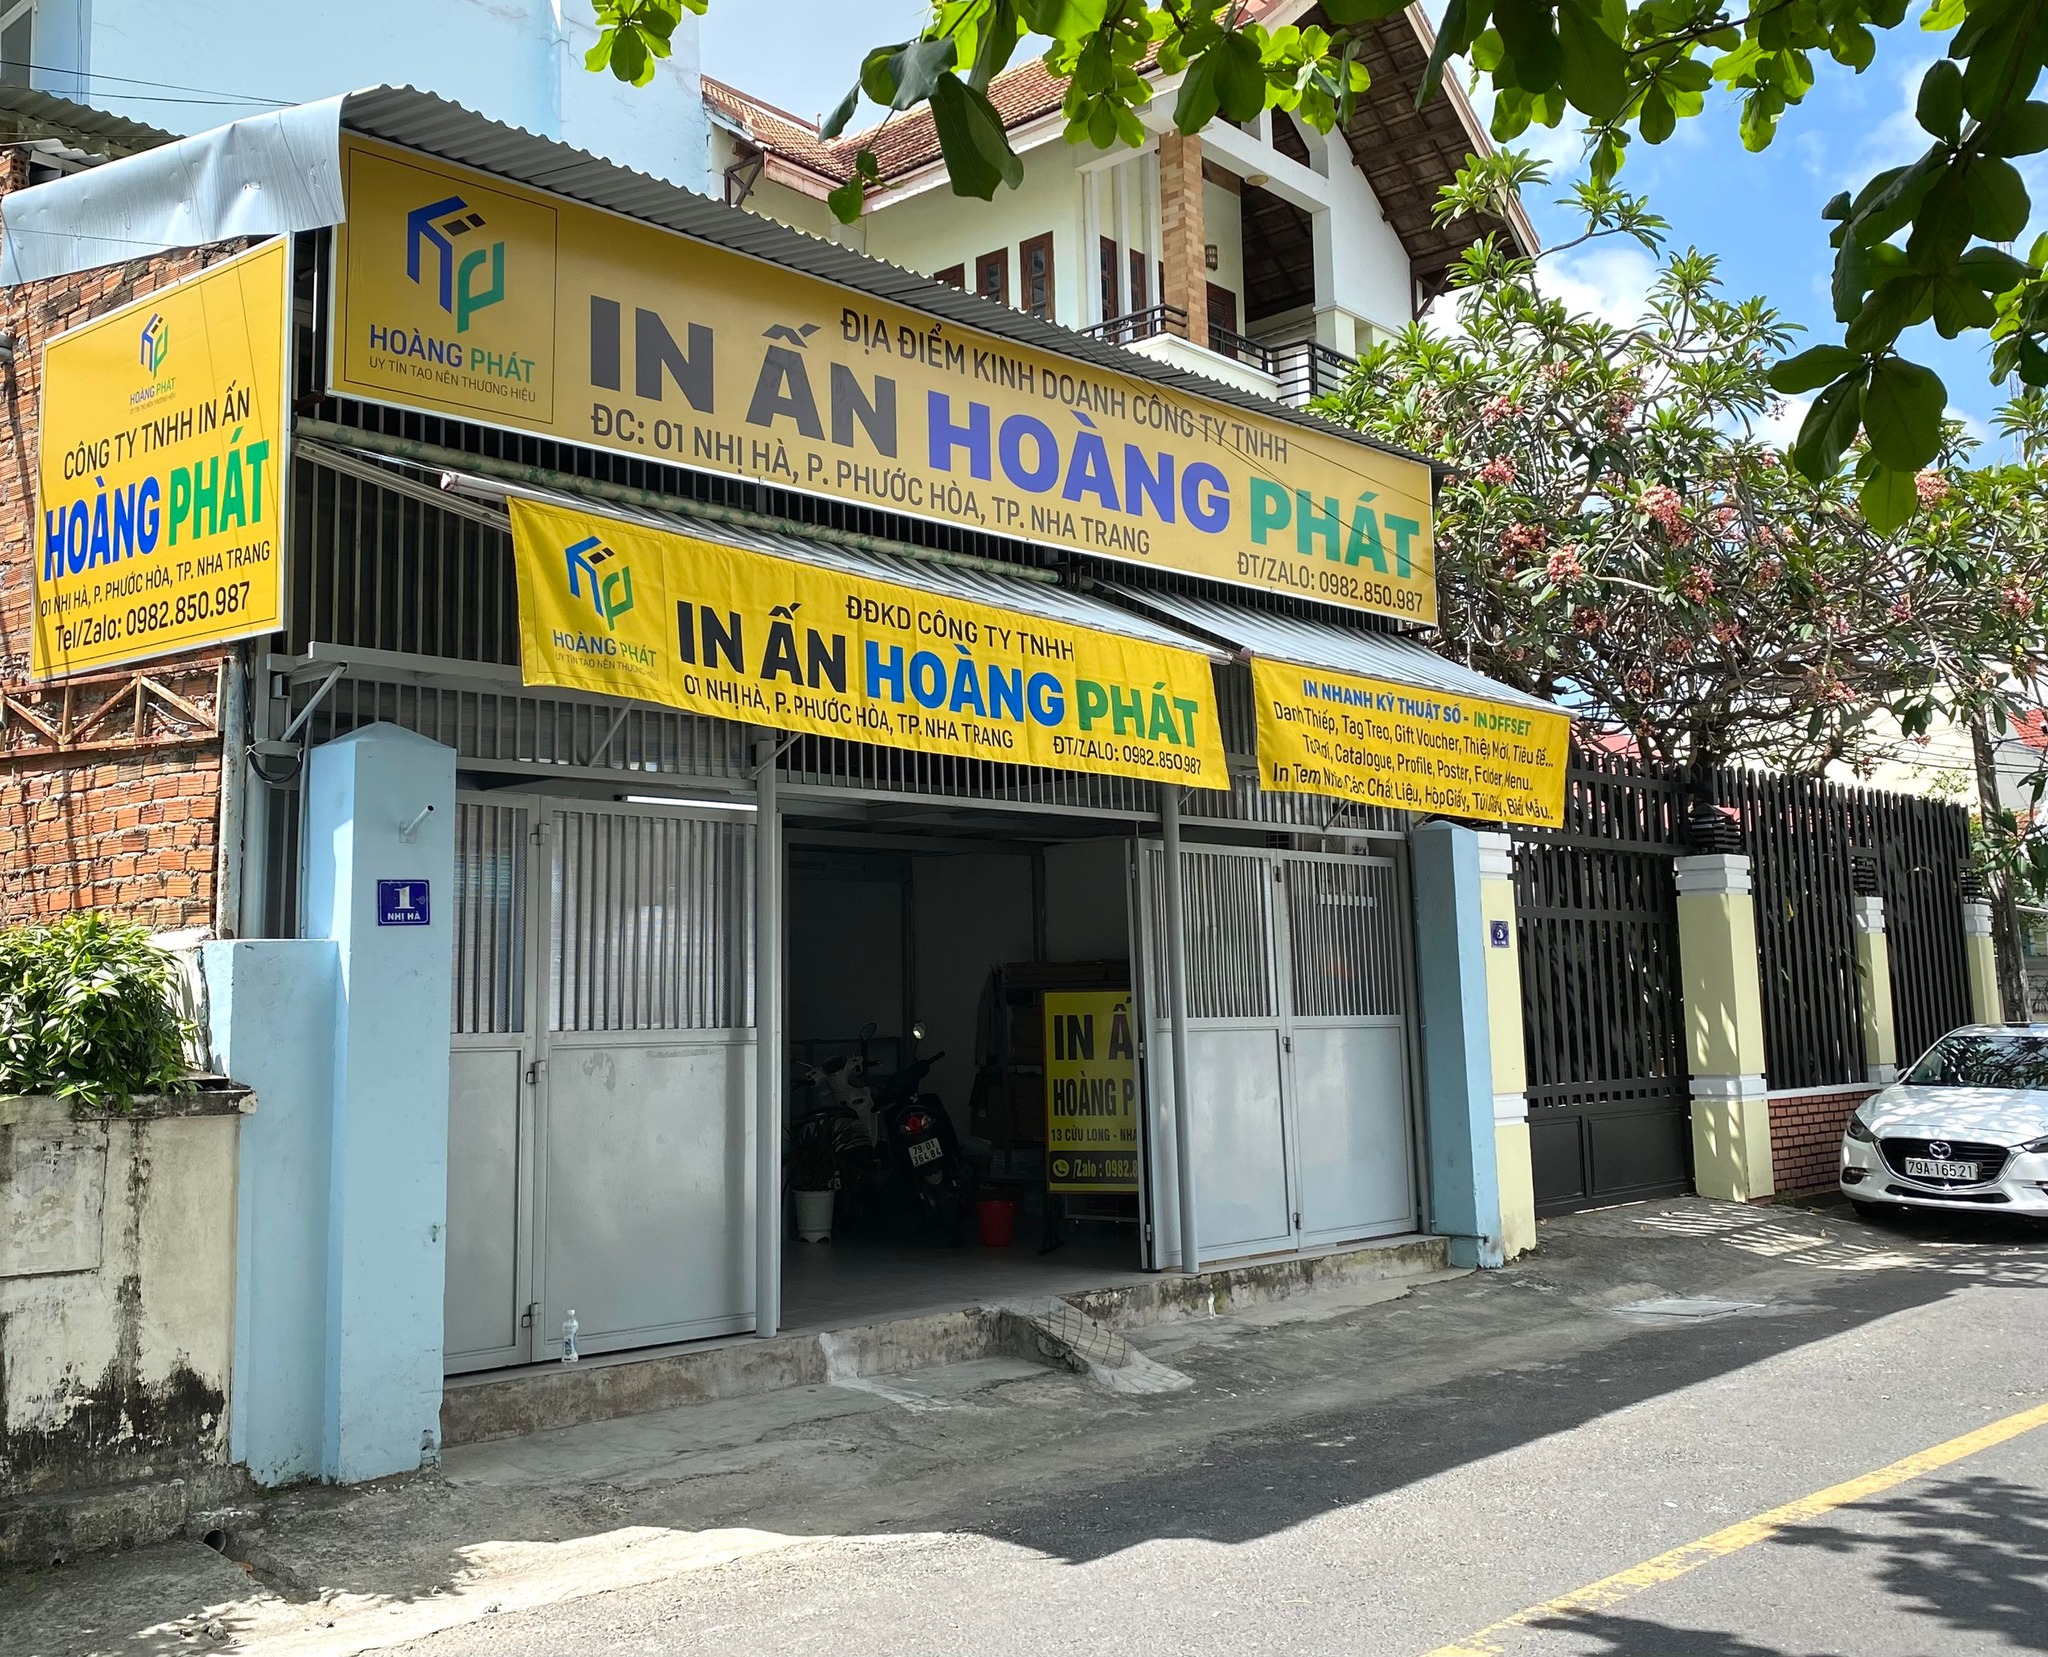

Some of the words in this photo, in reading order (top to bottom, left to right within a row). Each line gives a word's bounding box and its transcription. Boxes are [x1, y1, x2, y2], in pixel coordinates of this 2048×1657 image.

[369, 356, 386, 369] UY
[388, 358, 407, 375] TÍN
[410, 364, 432, 380] TẠO
[436, 369, 459, 386] NÊN
[462, 376, 508, 396] THƯƠNG
[510, 386, 536, 403] HIỆU
[370, 324, 463, 368] HOÀNG
[471, 347, 535, 383] PHÁT
[840, 307, 892, 355] ĐỊA
[897, 322, 965, 375] ĐIỂM
[973, 351, 1034, 394] KINH
[1041, 368, 1126, 420] DOANH
[1132, 393, 1195, 438] CÔNG
[1199, 414, 1227, 447] TY
[1231, 422, 1288, 464] TNHH
[64, 437, 111, 481] CÔNG
[115, 427, 138, 464] TY
[143, 408, 193, 457] TNHH
[198, 398, 218, 436] IN
[222, 380, 250, 428] ẤN
[590, 294, 714, 415] IN
[745, 323, 898, 459] ẤN
[927, 390, 1231, 534] HOÀNG
[1250, 476, 1420, 580] PHÁT
[45, 475, 160, 582] HOÀNG
[168, 426, 270, 547] PHÁT
[590, 403, 645, 445] ĐC:
[654, 421, 684, 452] 01
[694, 425, 743, 474] NHỊ
[752, 436, 798, 483] HÀ,
[807, 453, 829, 486] P.
[837, 459, 923, 506] PHƯỚC
[930, 482, 987, 526] HÒA,
[992, 495, 1024, 529] TP.
[1031, 505, 1076, 540] NHA
[1080, 516, 1151, 556] TRANG
[40, 597, 52, 619] 01
[53, 589, 71, 616] NHỊ
[73, 583, 91, 613] HÀ,
[93, 585, 104, 606] P.
[105, 571, 143, 602] PHƯỚC
[145, 565, 173, 594] HÒA,
[176, 560, 194, 585] TP.
[197, 553, 222, 577] NHA
[226, 539, 271, 568] TRANG
[1237, 551, 1315, 591] ĐT/ZALO:
[1319, 571, 1423, 613] 0982.850.987
[54, 613, 122, 652] Tel/Zalo:
[126, 581, 251, 637] 0982.850.987
[846, 595, 912, 631] ĐĐKD
[918, 609, 978, 644] CÔNG
[983, 624, 1011, 651] TY
[1016, 631, 1074, 663] TNHH
[553, 629, 617, 656] HOÀNG
[619, 641, 657, 668] PHÁT
[677, 600, 745, 675] IN
[760, 602, 847, 695] ẤN
[865, 640, 1065, 728] HOÀNG
[1076, 678, 1198, 748] PHÁT
[684, 674, 702, 698] 01
[706, 679, 739, 711] NHỊ
[742, 684, 771, 715] HÀ,
[776, 691, 791, 715] P.
[794, 695, 852, 724] PHƯỚC
[856, 704, 894, 737] HÒA,
[897, 713, 922, 737] TP.
[926, 718, 960, 742] NHA
[963, 724, 1013, 749] TRANG
[1303, 679, 1318, 699] IN
[1322, 683, 1373, 709] NHANH
[1376, 691, 1394, 713] KỸ
[1397, 697, 1441, 724] THUẬT
[1443, 702, 1461, 724] SỐ
[1489, 714, 1531, 737] OFFSET
[1304, 707, 1339, 736] Thiếp,
[1341, 715, 1364, 740] Tag
[1365, 719, 1393, 745] Treo,
[1395, 724, 1415, 745] Gift
[1416, 727, 1462, 756] Voucher,
[1513, 745, 1534, 764] Tiêu
[1053, 735, 1119, 762] ĐT/ZALO:
[1123, 745, 1201, 775] 0982.850987
[1335, 744, 1395, 773] Catalogue,
[1397, 753, 1435, 779] Profile,
[1437, 760, 1472, 785] Poster,
[1273, 762, 1289, 782] In
[1293, 763, 1321, 785] Tem
[1395, 782, 1422, 806] Liệu,
[1425, 785, 1445, 809] Hộp
[1446, 788, 1470, 812] Giấy,
[387, 912, 405, 922] NHỊ
[407, 911, 421, 920] HÀ
[394, 886, 415, 909] 1
[1054, 1014, 1094, 1061] IN
[1053, 1070, 1117, 1117] HOÀNG
[1051, 1128, 1062, 1142] 13
[1087, 1128, 1111, 1142] LONG
[1908, 1161, 1973, 1178] 79A-165.21
